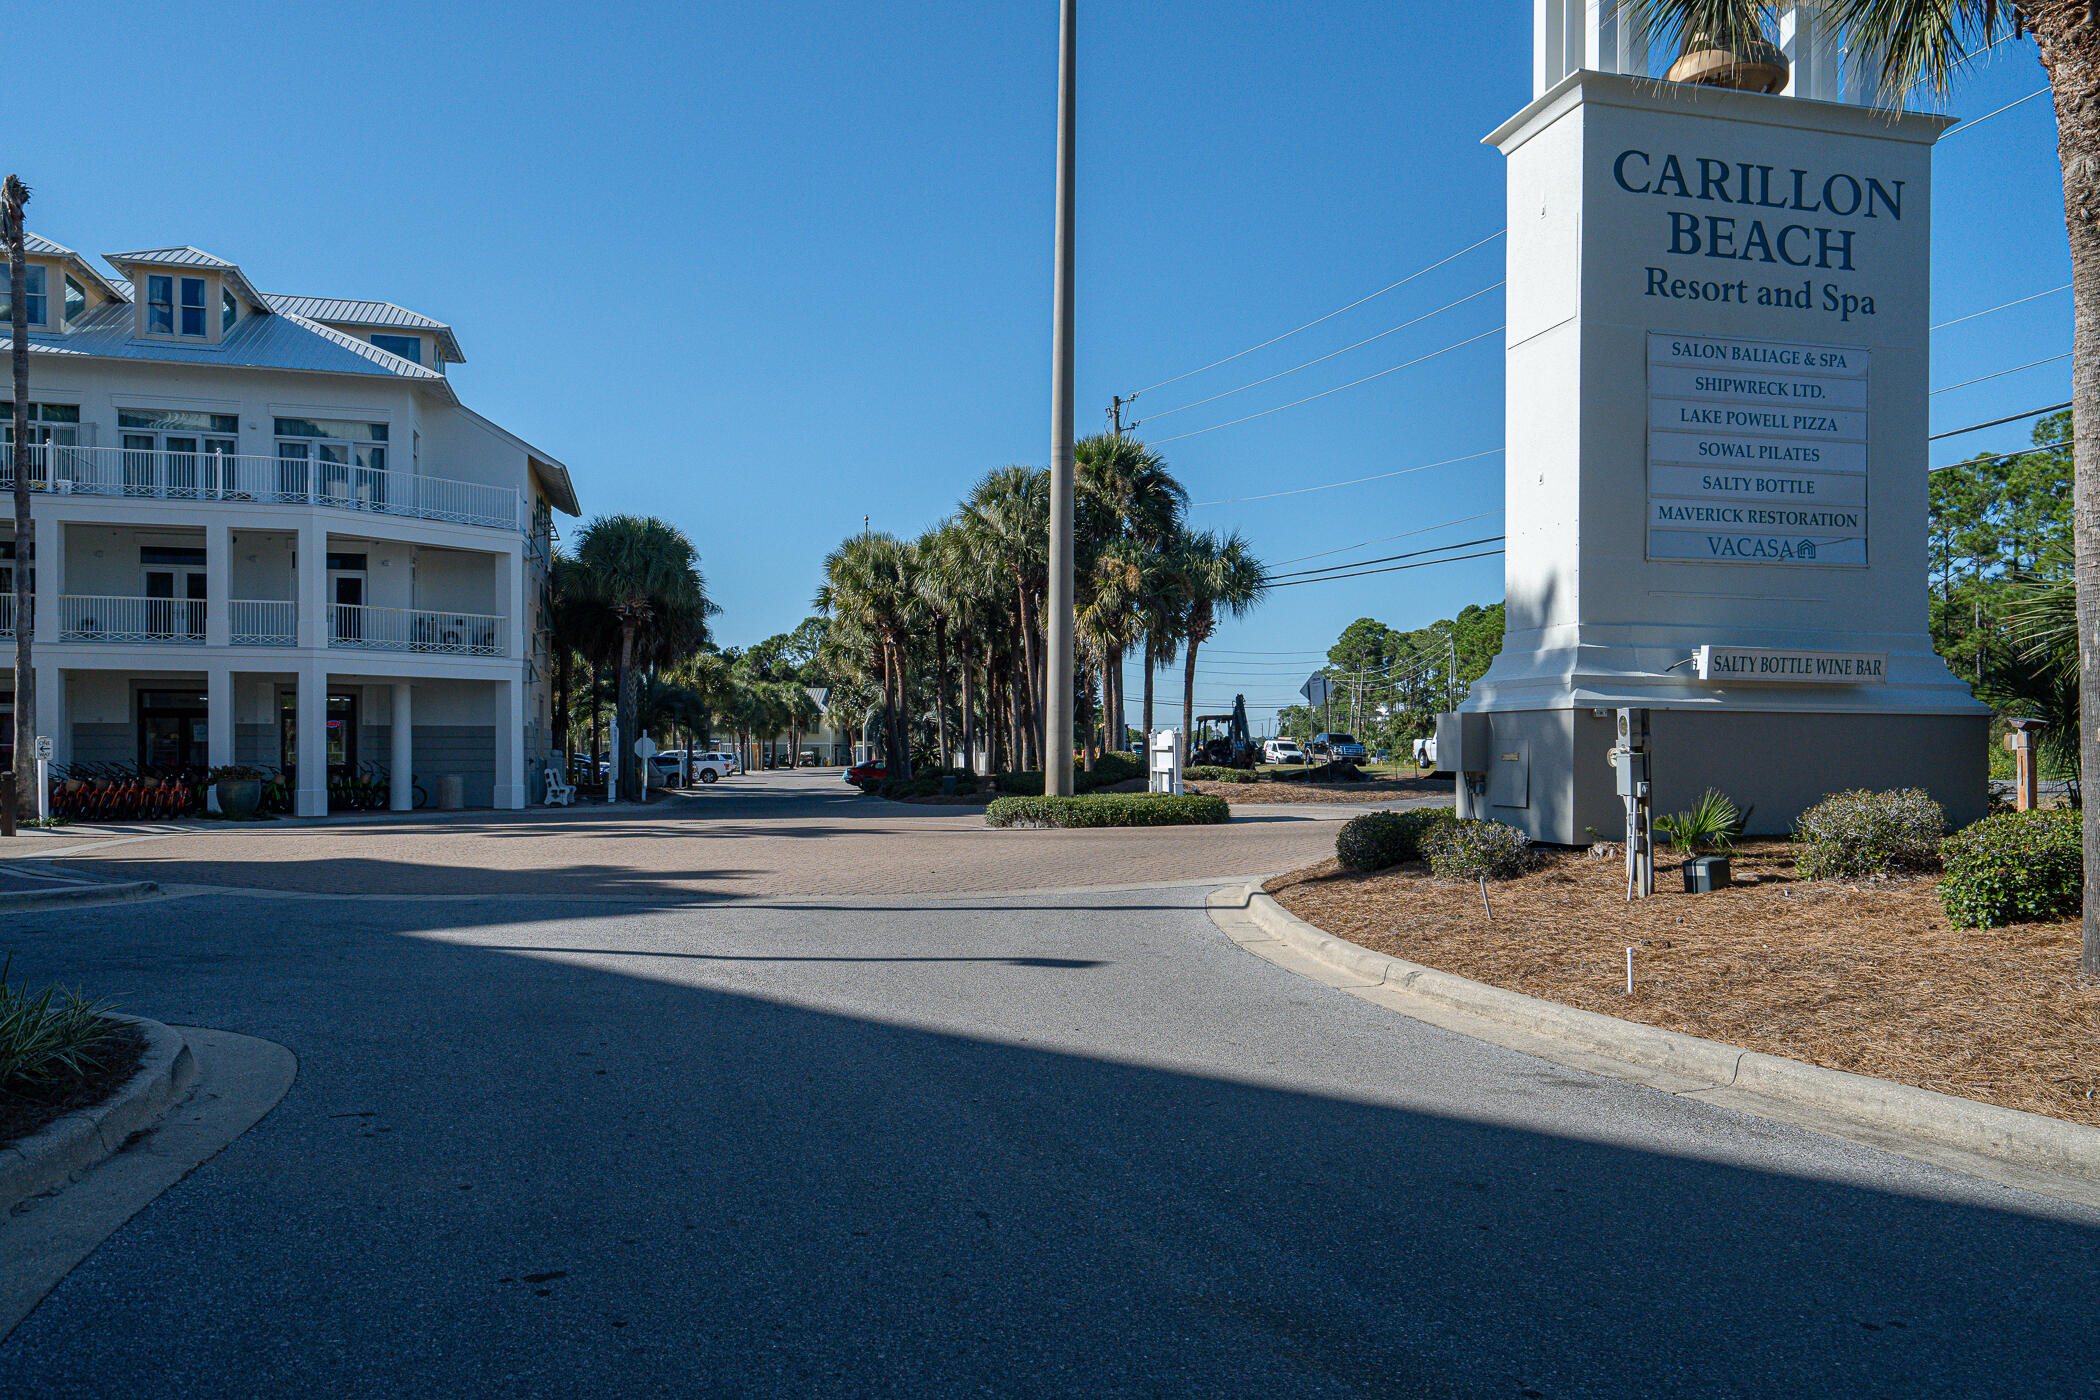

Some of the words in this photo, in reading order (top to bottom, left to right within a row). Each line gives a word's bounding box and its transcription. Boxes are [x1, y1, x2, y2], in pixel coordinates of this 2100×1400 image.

[1613, 149, 1906, 221] CARILLON
[1666, 211, 1856, 272] BEACH
[1645, 267, 1748, 303] Resort
[1758, 280, 1812, 309] and
[1823, 284, 1876, 321] Spa
[1672, 342, 1727, 359] SALON
[1732, 347, 1801, 365] BALIAGE
[1804, 352, 1815, 366] &
[1820, 353, 1846, 368] SPA
[1696, 377, 1788, 396] SHIPWRECK
[1793, 384, 1825, 398] LTD.
[1681, 408, 1721, 424] LAKE
[1726, 411, 1789, 428] POWELL
[1793, 416, 1837, 431] PIZZA
[1699, 442, 1754, 458] SOWAL
[1759, 446, 1819, 462] PILATES
[1703, 476, 1752, 491] SALTY
[1756, 479, 1815, 494] BOTTLE
[1659, 506, 1743, 522] MAVERICK
[1749, 510, 1858, 527] RESTORATION
[1708, 537, 1794, 558] VACASA
[1714, 656, 1757, 672] SALTY
[1761, 657, 1812, 673] BOTTLE
[1816, 659, 1852, 675] WINE
[1856, 660, 1881, 675] BAR
